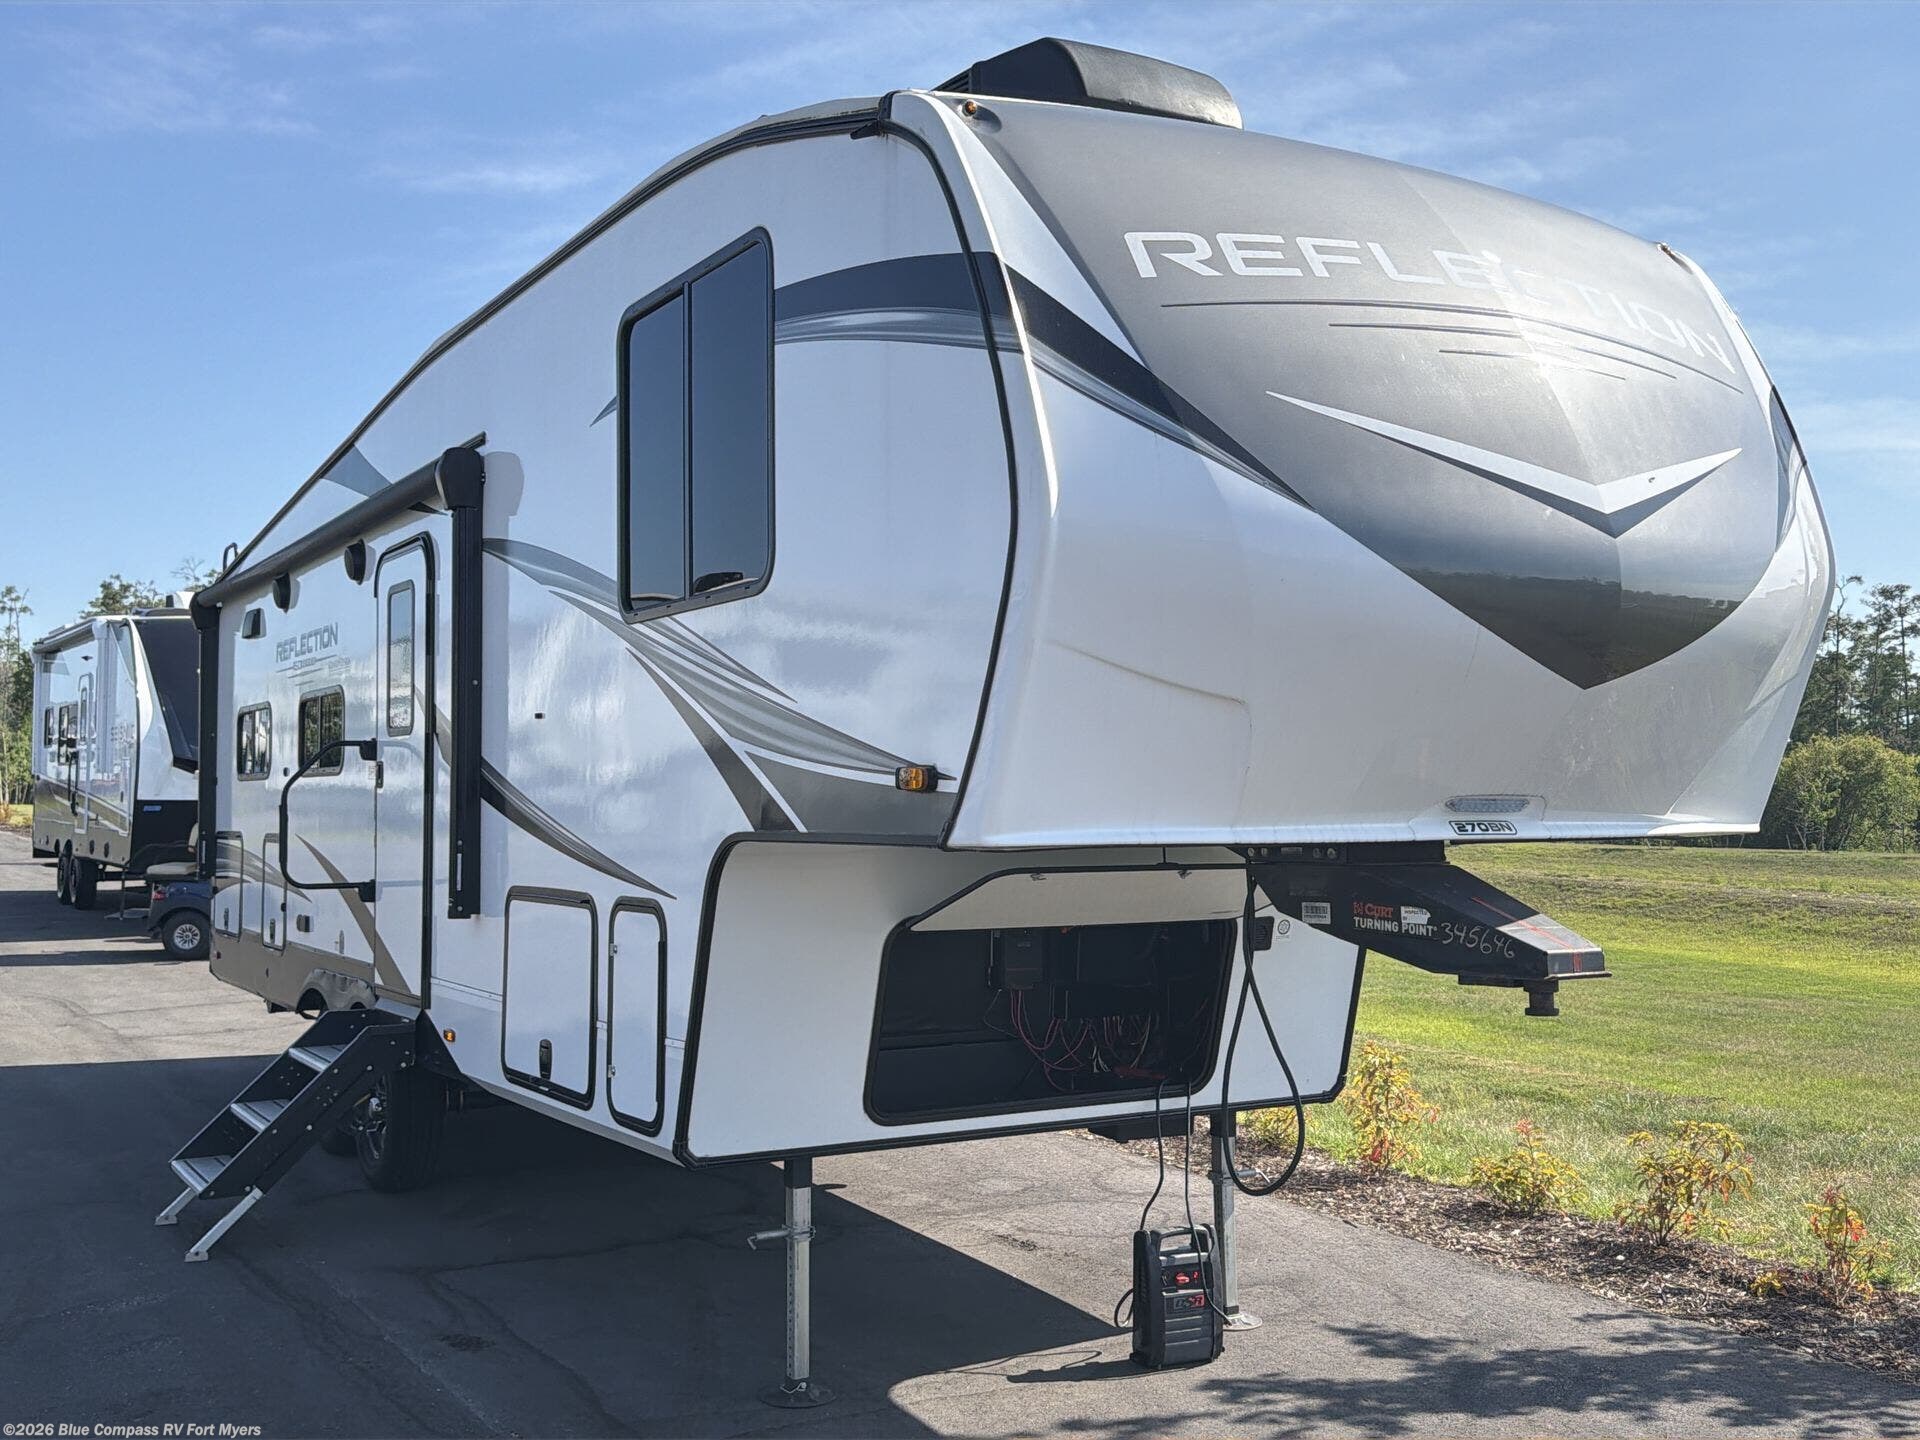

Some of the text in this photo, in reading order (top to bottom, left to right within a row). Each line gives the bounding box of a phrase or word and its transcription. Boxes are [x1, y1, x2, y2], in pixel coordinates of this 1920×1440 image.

[1124, 231, 1736, 375] REFLECTION
[276, 622, 338, 662] REFLECTION
[1455, 822, 1513, 833] 270BN
[1353, 916, 1399, 932] TURNING
[1441, 922, 1515, 958] 345646
